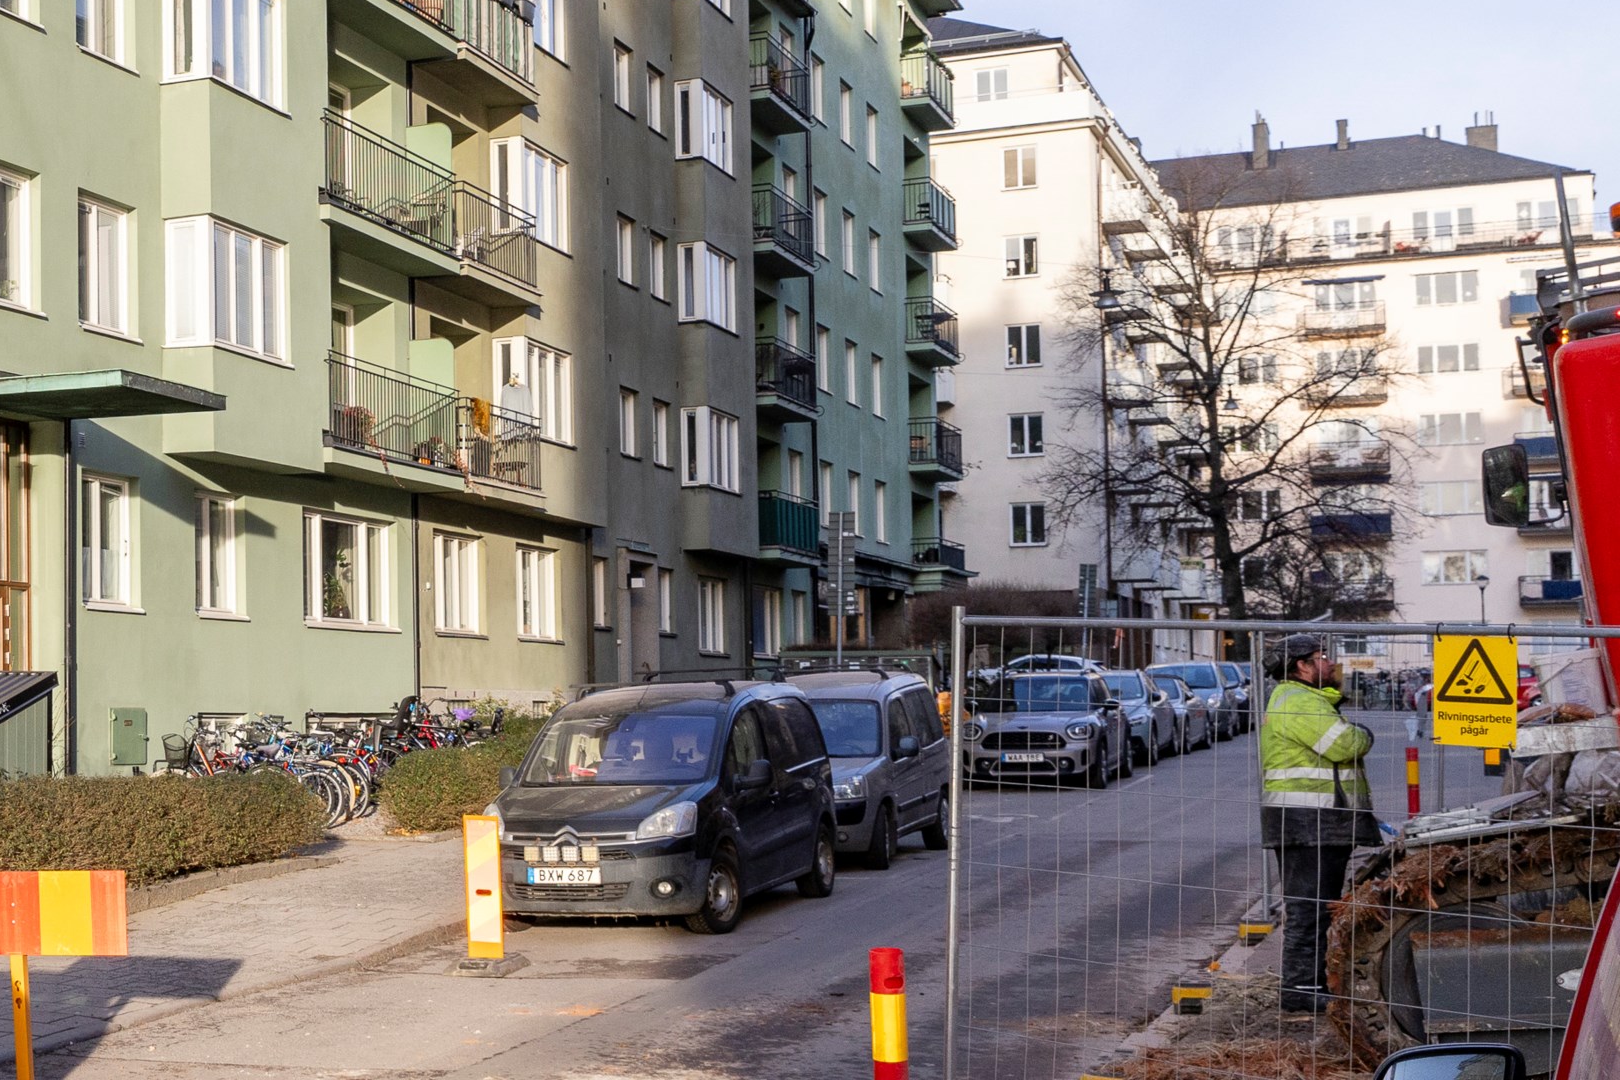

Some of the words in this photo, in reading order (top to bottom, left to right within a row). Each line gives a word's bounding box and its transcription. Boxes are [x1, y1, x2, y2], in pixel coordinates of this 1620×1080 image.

[1437, 710, 1513, 724] Rivningsarbete
[1460, 724, 1489, 736] pågår
[539, 869, 564, 882] BXW
[567, 869, 593, 882] 687
